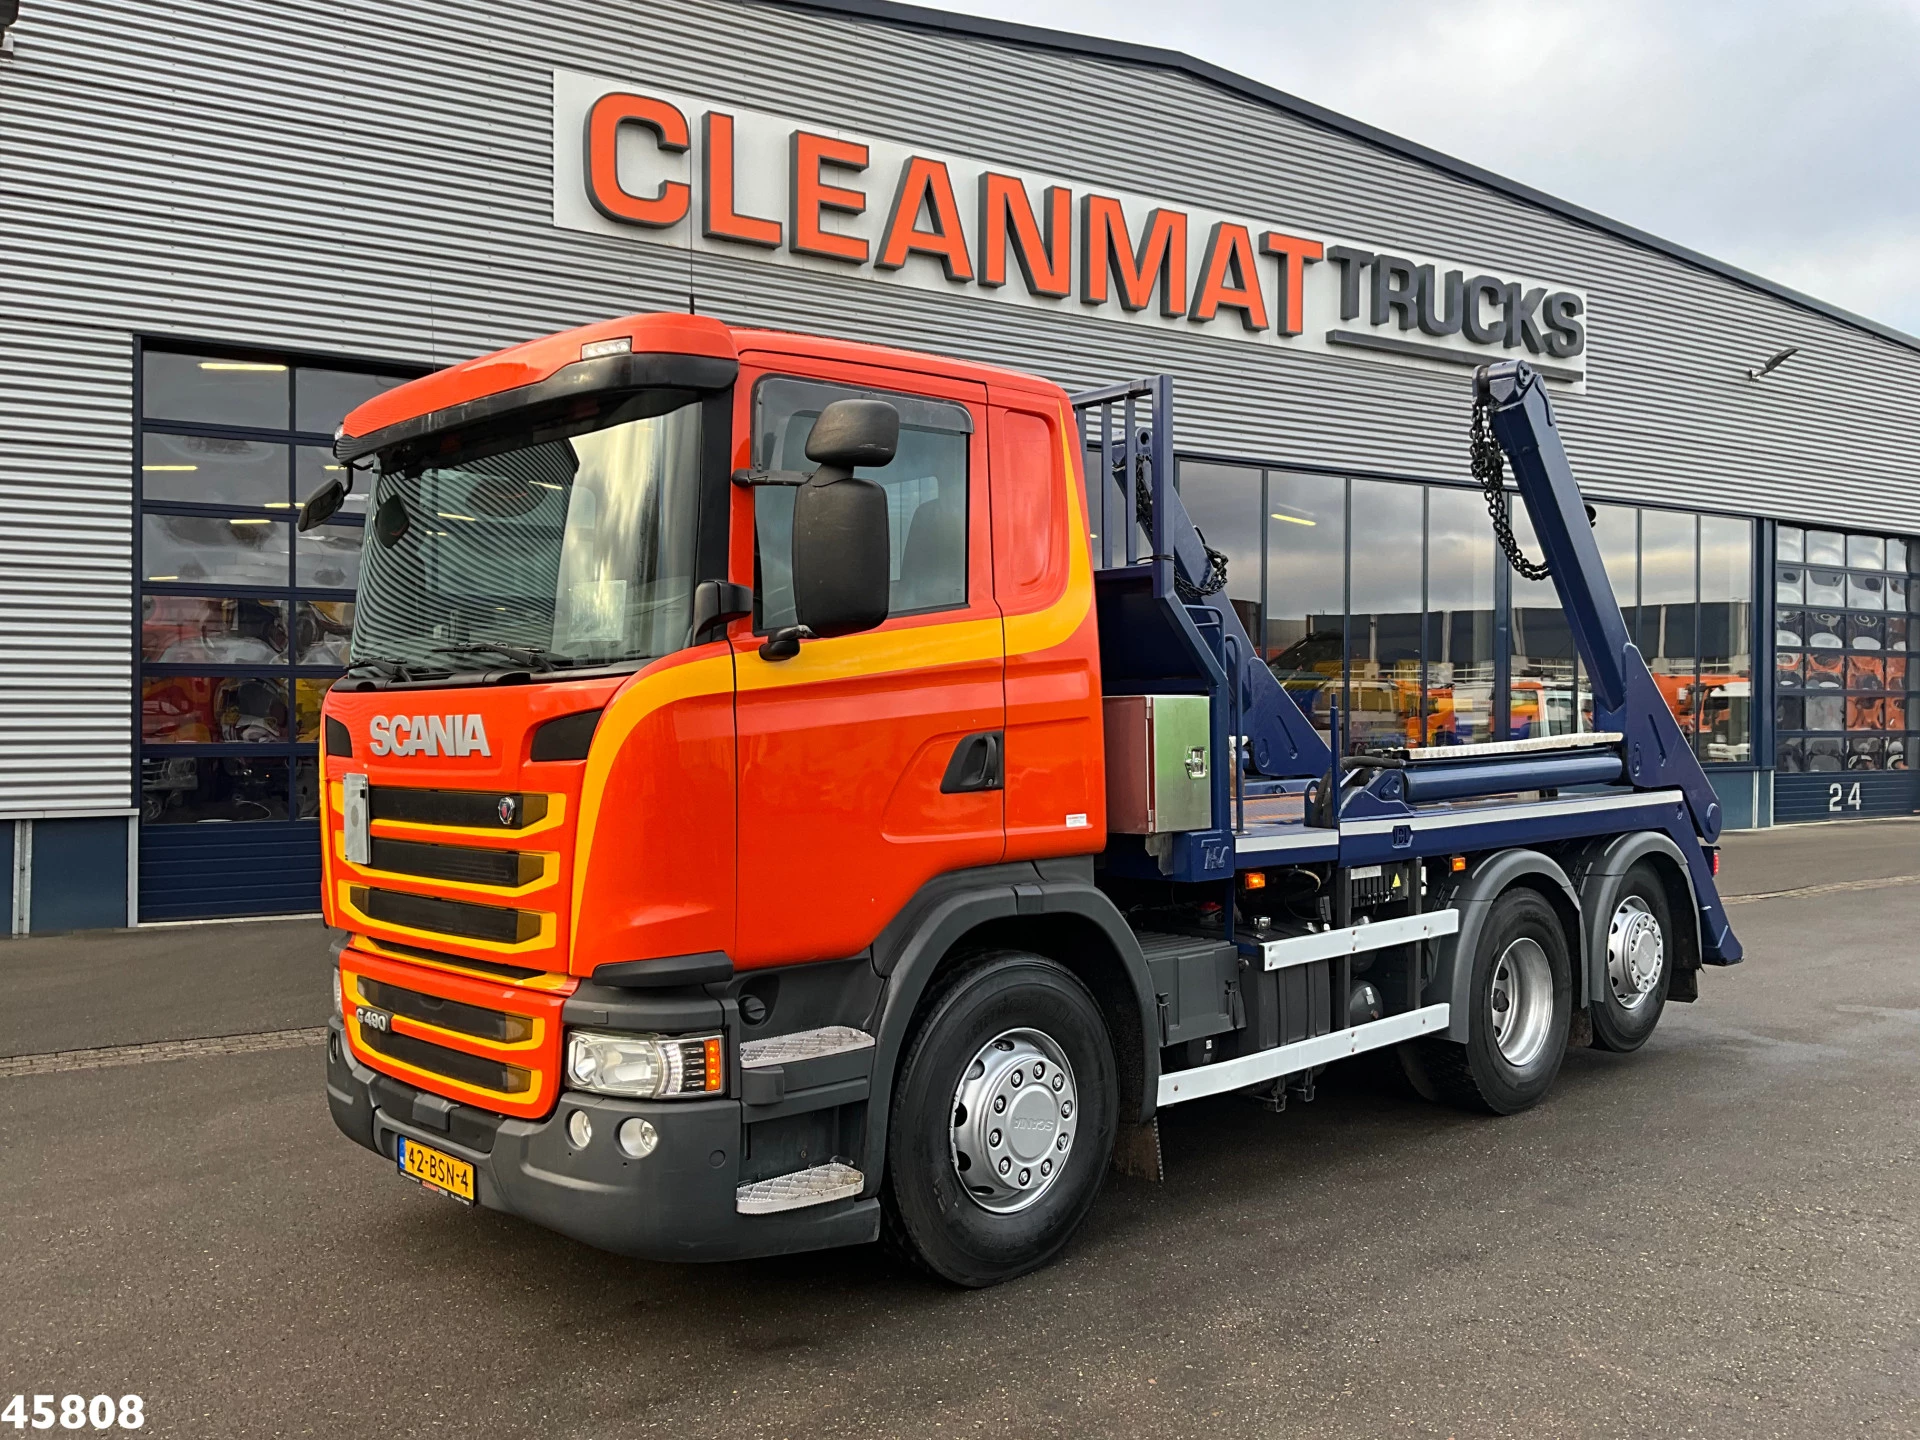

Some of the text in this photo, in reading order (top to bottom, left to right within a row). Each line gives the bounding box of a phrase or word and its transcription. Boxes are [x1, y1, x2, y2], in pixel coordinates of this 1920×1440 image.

[583, 91, 1585, 359] CLEANMAT TRUCKS
[369, 714, 491, 756] SCANIA
[1829, 782, 1862, 811] 24
[364, 1011, 386, 1032] 490
[408, 1147, 469, 1193] 42-BSN-4
